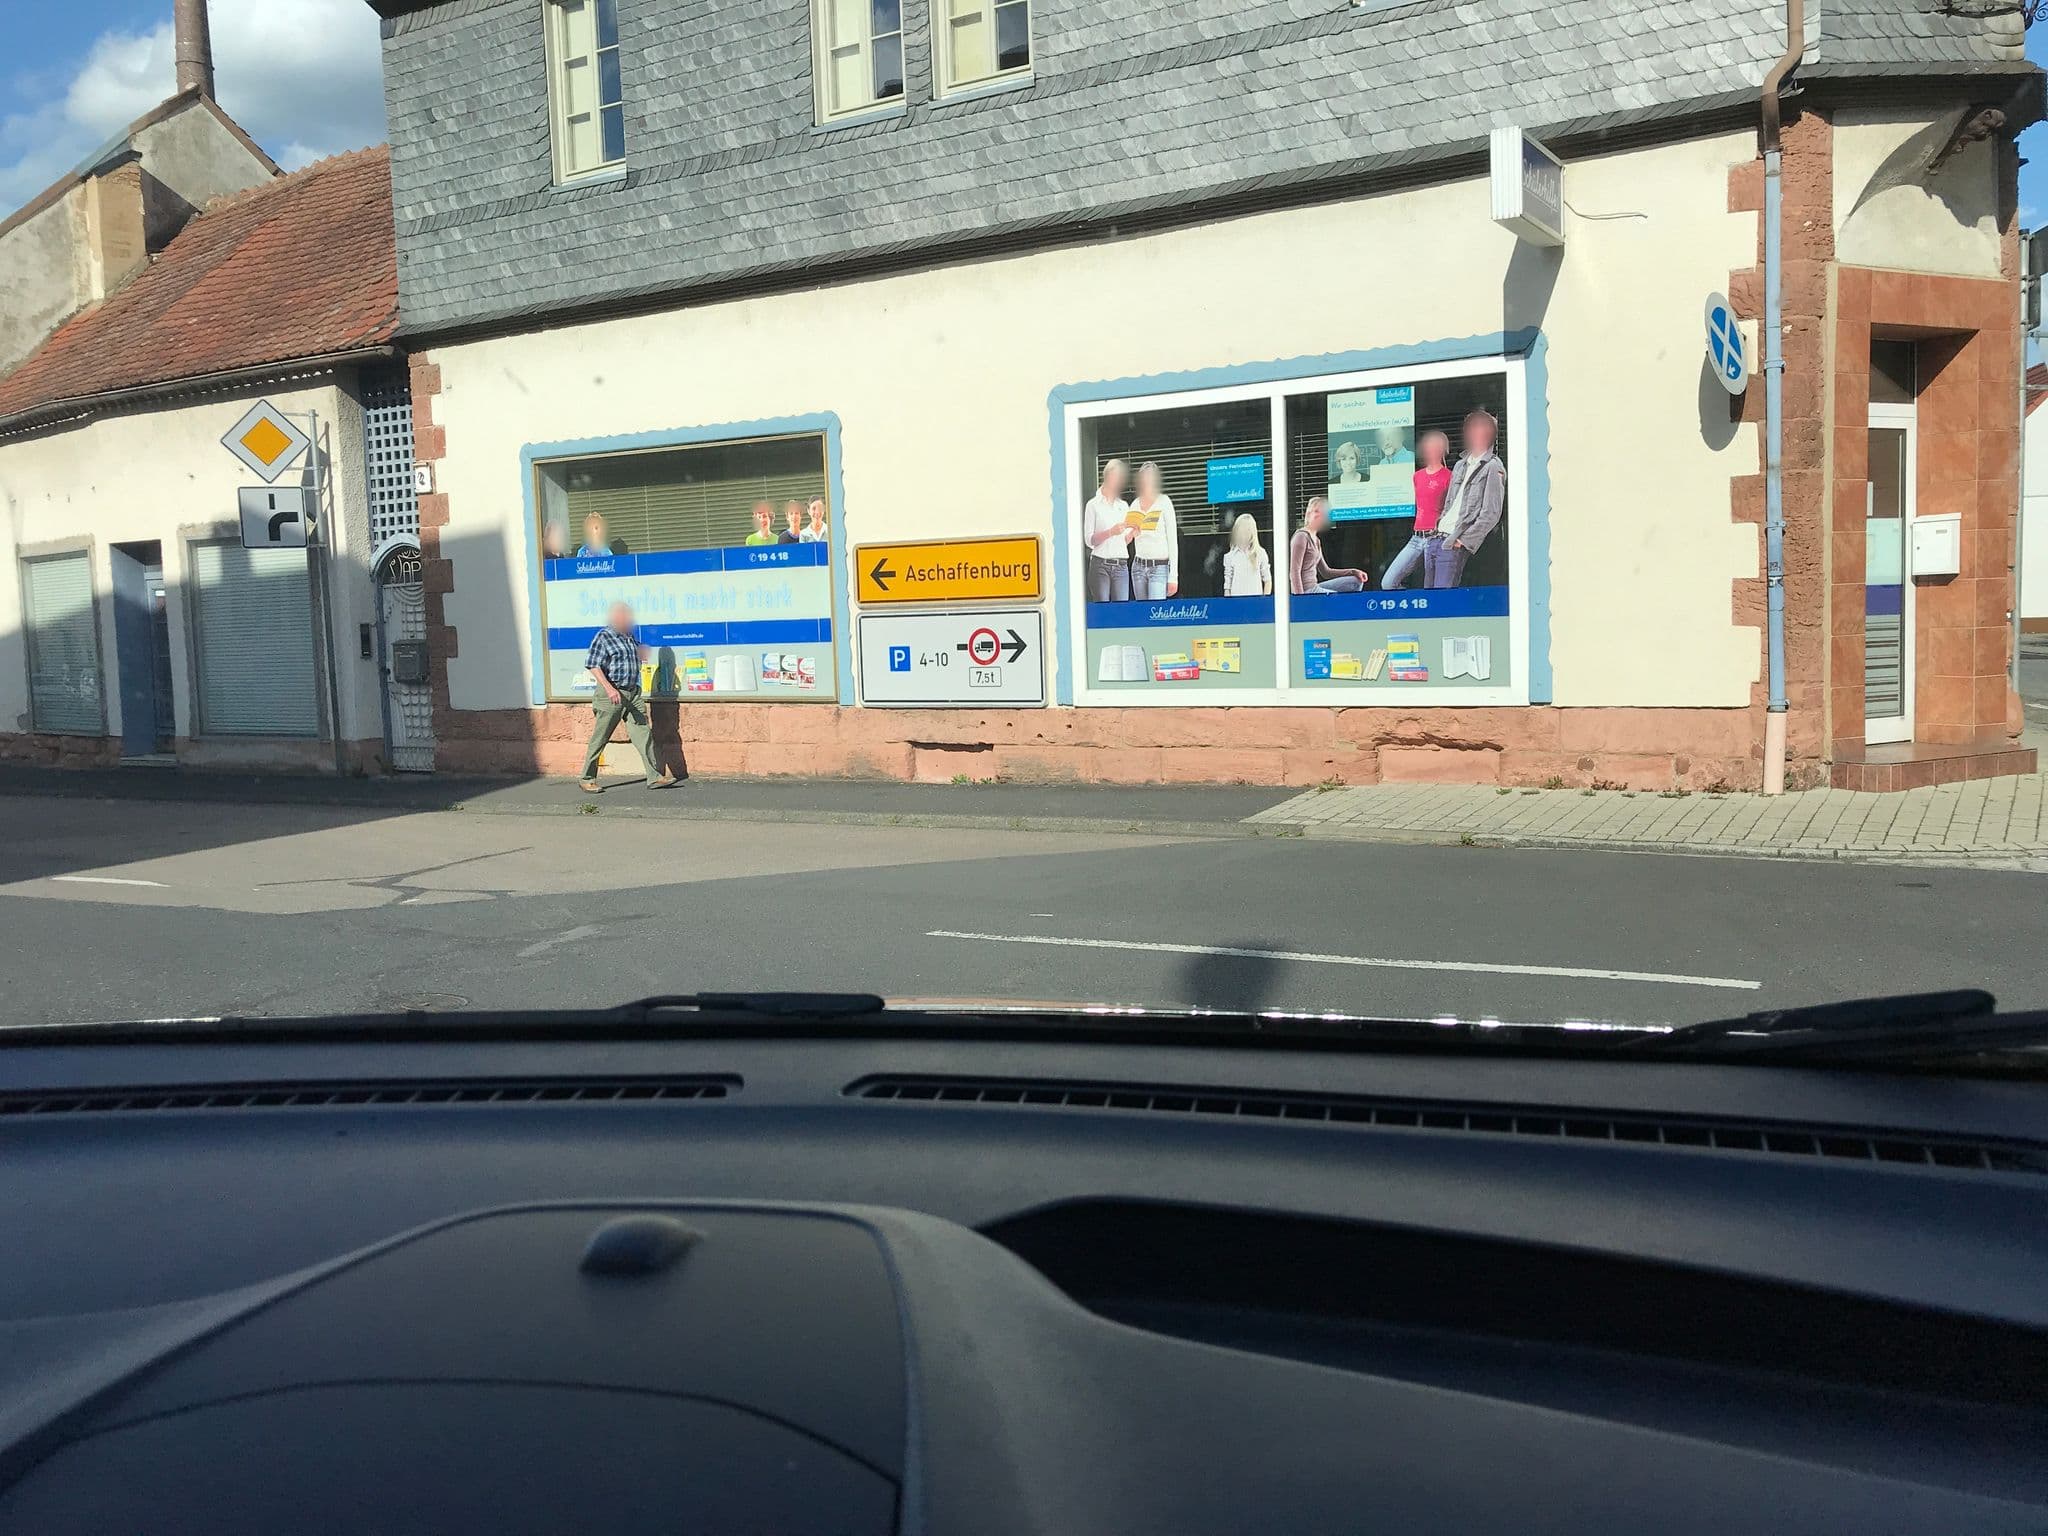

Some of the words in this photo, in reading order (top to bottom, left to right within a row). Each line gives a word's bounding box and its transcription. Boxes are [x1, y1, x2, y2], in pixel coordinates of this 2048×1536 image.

[757, 553, 769, 562] 19
[769, 552, 777, 561] 4
[778, 551, 789, 560] 18
[905, 561, 1031, 582] Aschaffenburg
[1149, 603, 1209, 621] Schülerhilfe!
[1380, 599, 1396, 610] 19
[1399, 599, 1408, 609] 4
[1411, 598, 1428, 609] 18
[894, 649, 906, 669] P
[919, 652, 949, 668] 4-10
